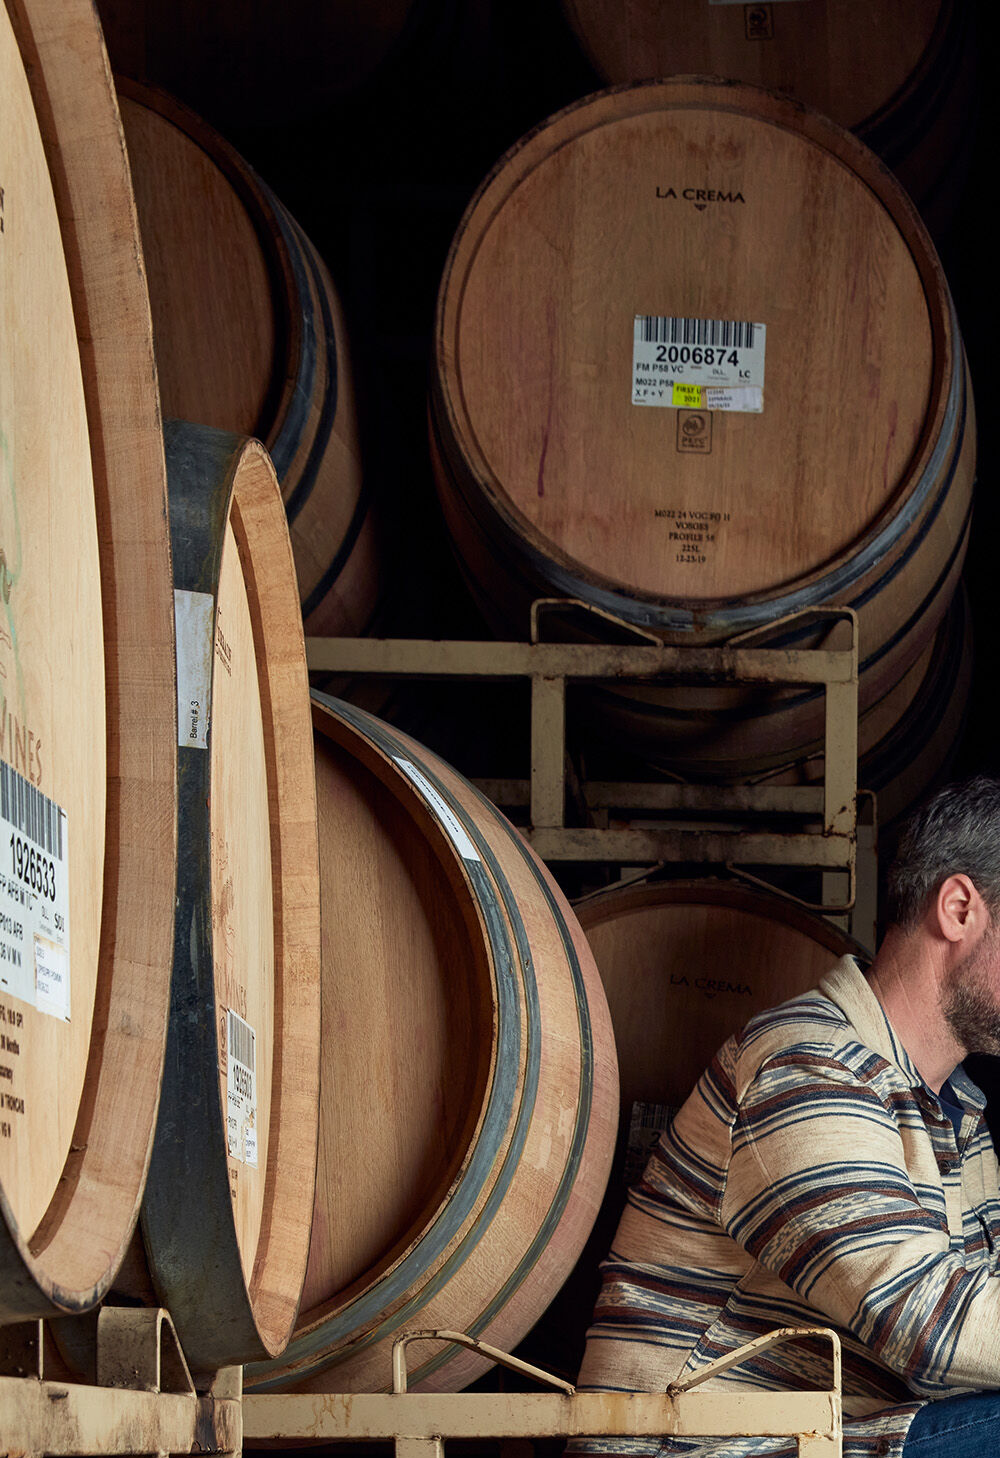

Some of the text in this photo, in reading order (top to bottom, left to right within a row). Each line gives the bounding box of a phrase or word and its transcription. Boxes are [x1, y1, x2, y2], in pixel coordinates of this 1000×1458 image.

[656, 186, 745, 204] LA CREMA
[656, 345, 739, 367] 2006874
[636, 362, 650, 372] FM
[671, 365, 684, 374] VC
[739, 369, 751, 379] LC
[190, 715, 199, 739] Barrel
[10, 832, 56, 902] 1926533
[670, 974, 752, 996] LA CREMA
